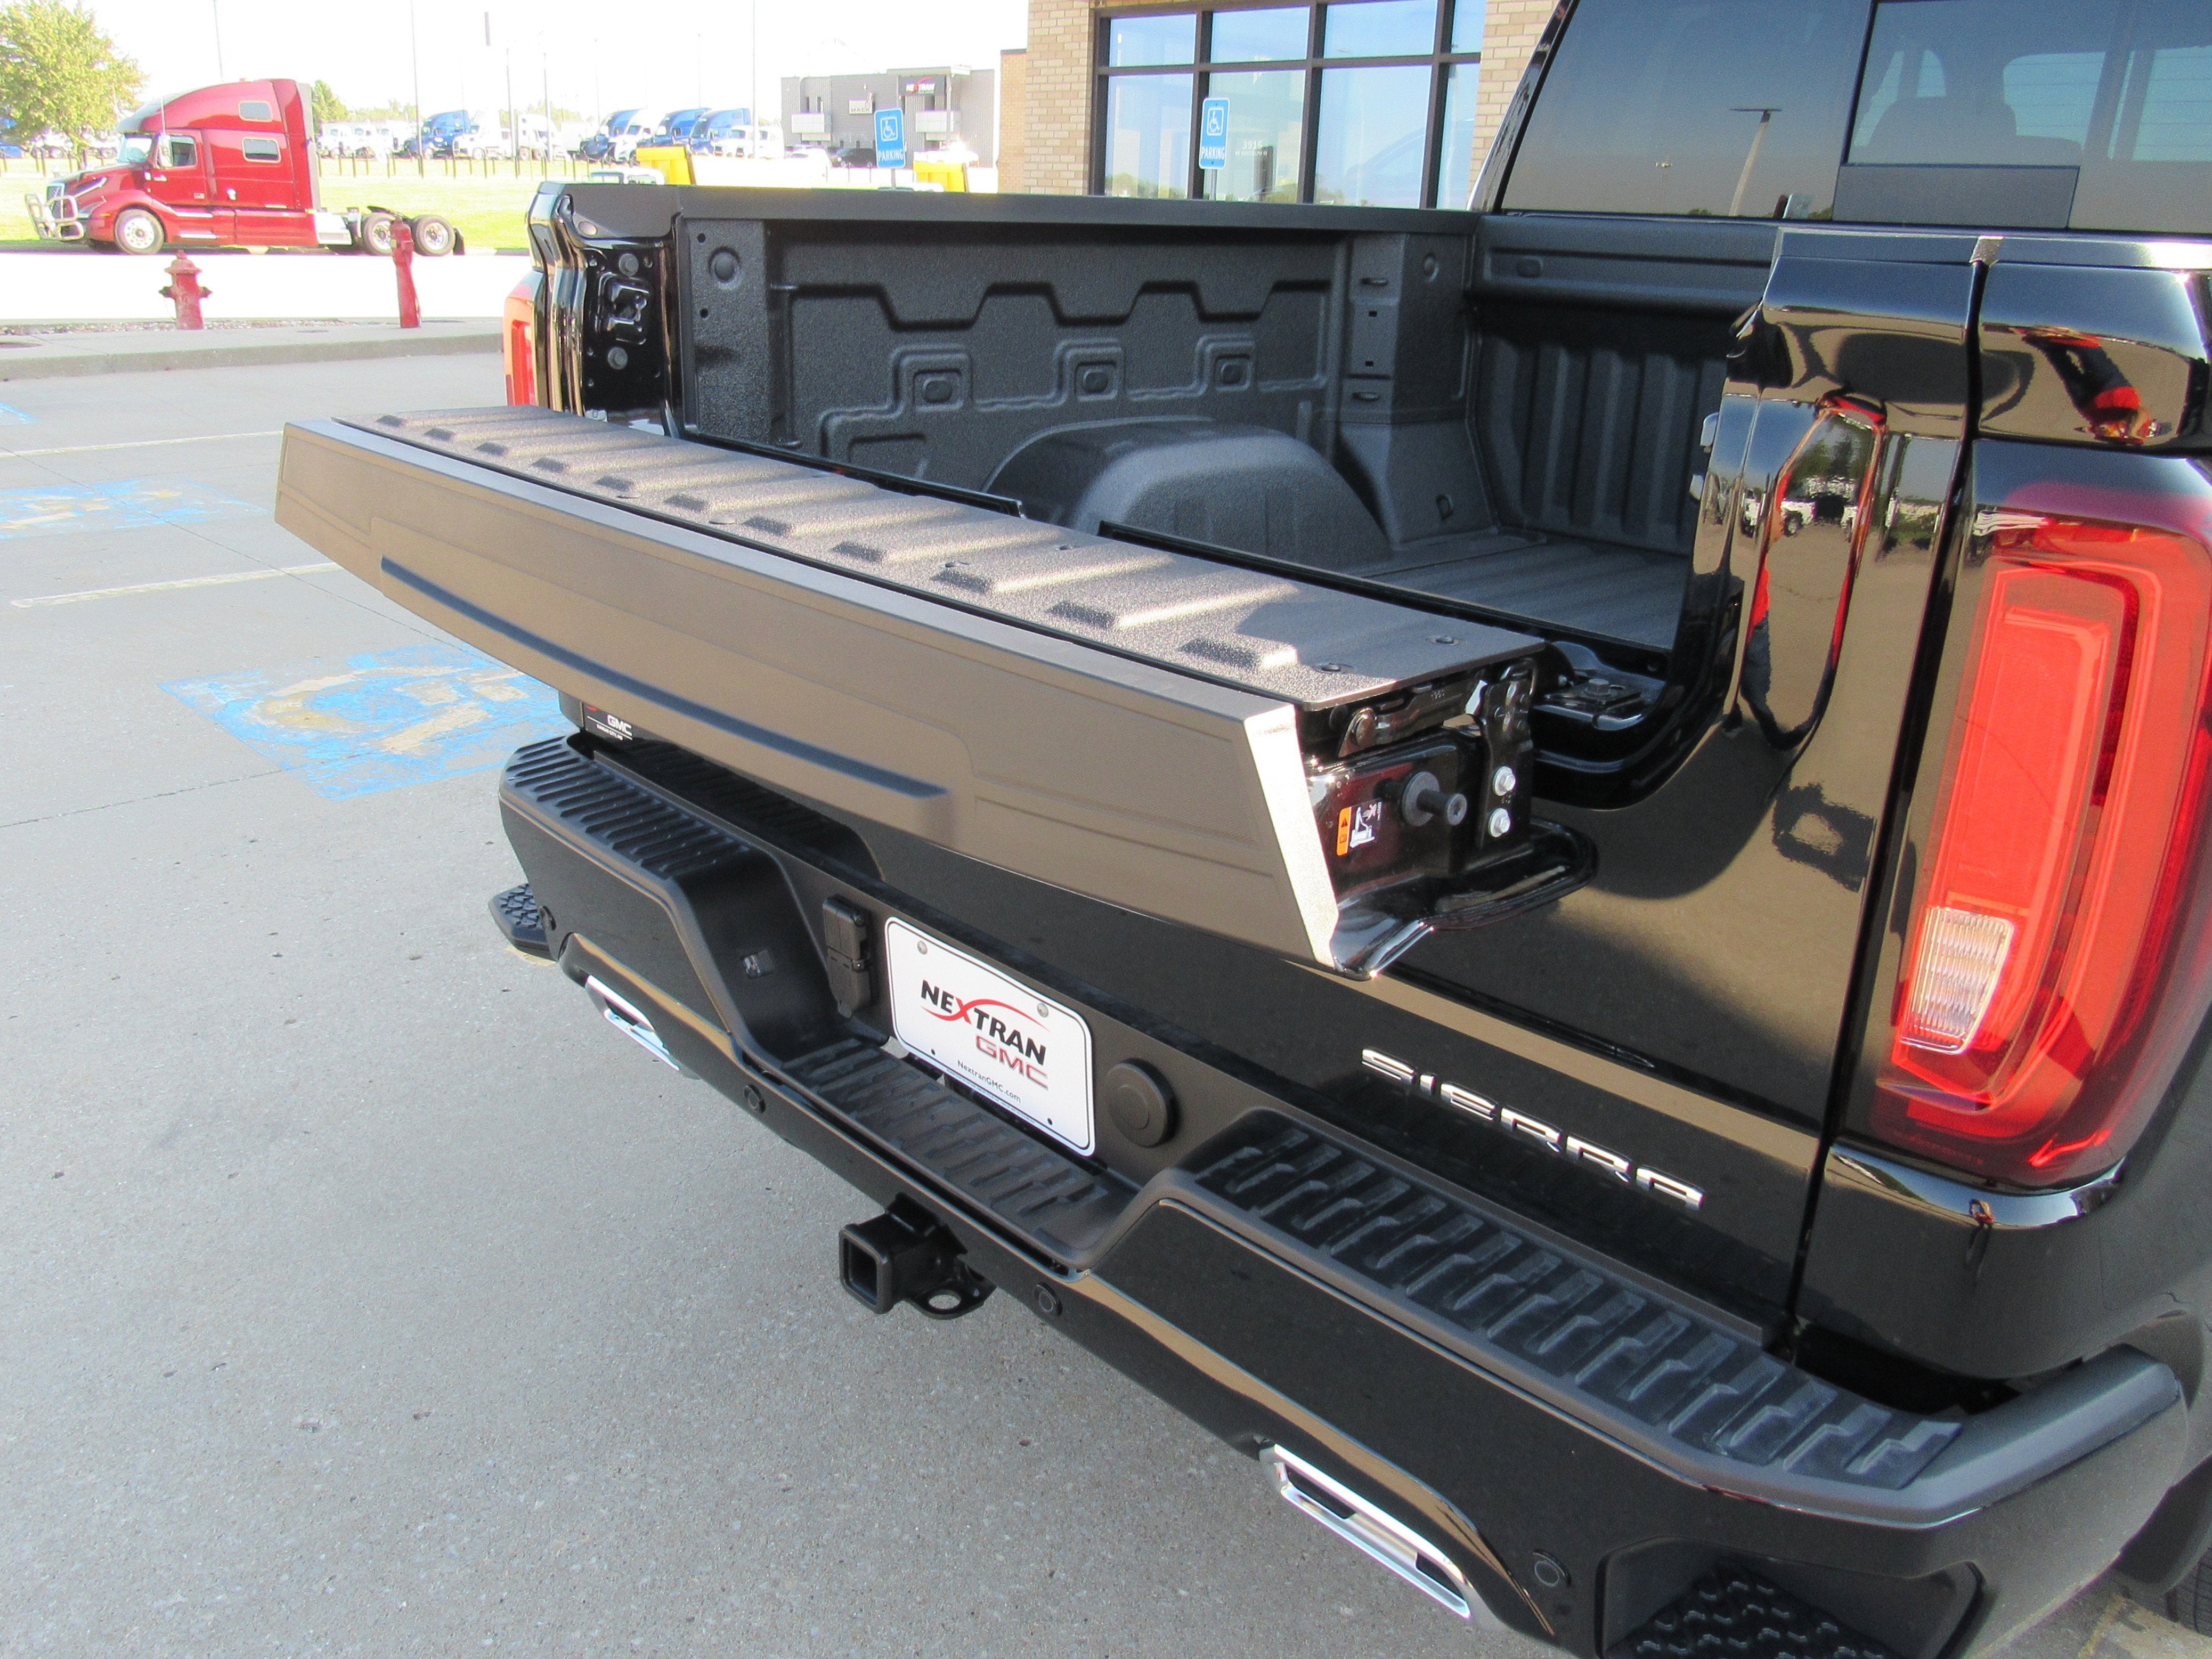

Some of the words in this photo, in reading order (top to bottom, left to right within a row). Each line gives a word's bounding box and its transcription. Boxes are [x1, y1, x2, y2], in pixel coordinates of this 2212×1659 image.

[878, 149, 904, 161] PARKING
[1201, 147, 1225, 160] PARKING
[607, 714, 633, 736] GMC
[921, 979, 1046, 1066] NEXTRAN
[957, 1059, 1021, 1103] NextranGMC.com
[976, 1034, 1048, 1091] GMC
[1361, 1047, 1706, 1210] SIERRA
